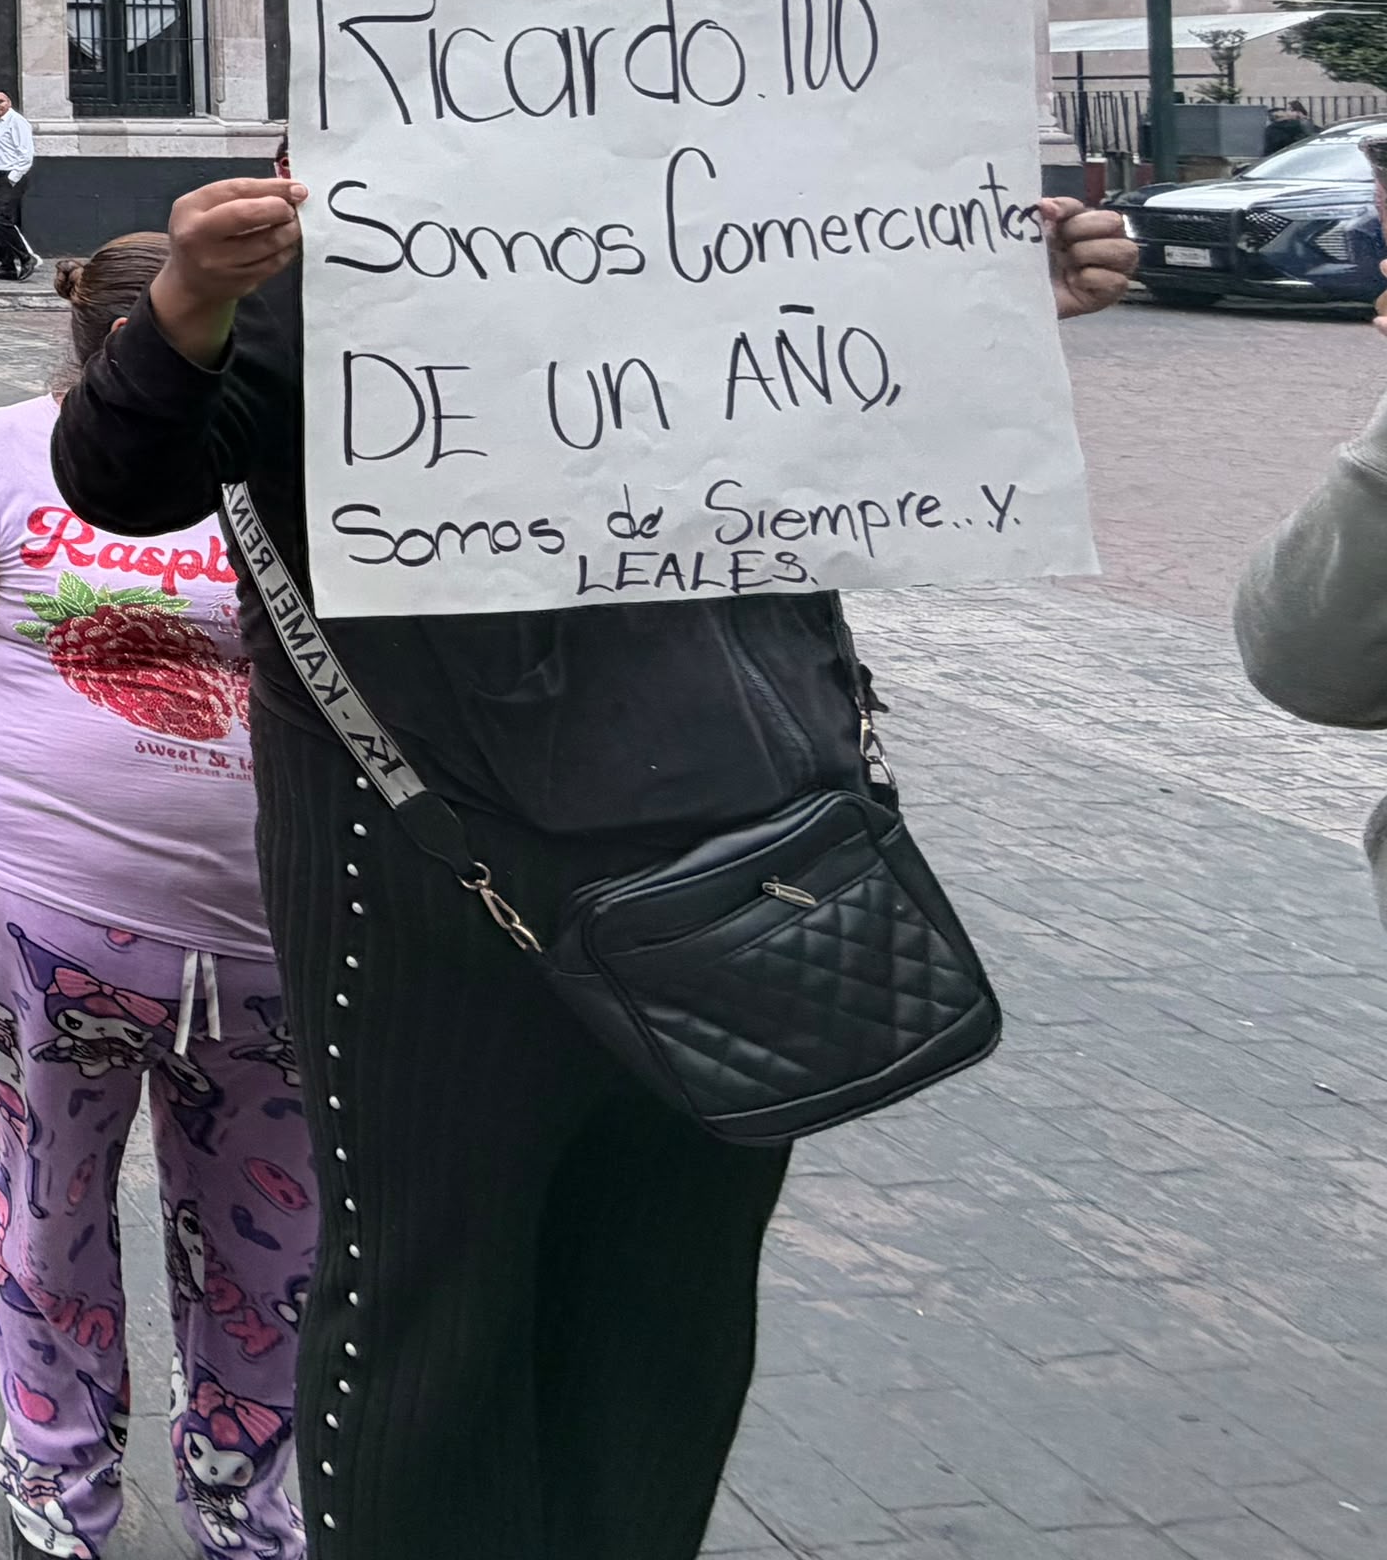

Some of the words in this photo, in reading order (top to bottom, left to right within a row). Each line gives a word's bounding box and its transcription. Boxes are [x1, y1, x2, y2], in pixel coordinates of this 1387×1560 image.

[324, 179, 647, 284] Somos
[341, 349, 489, 469] DE
[331, 502, 567, 568] Somos
[607, 483, 665, 541] de
